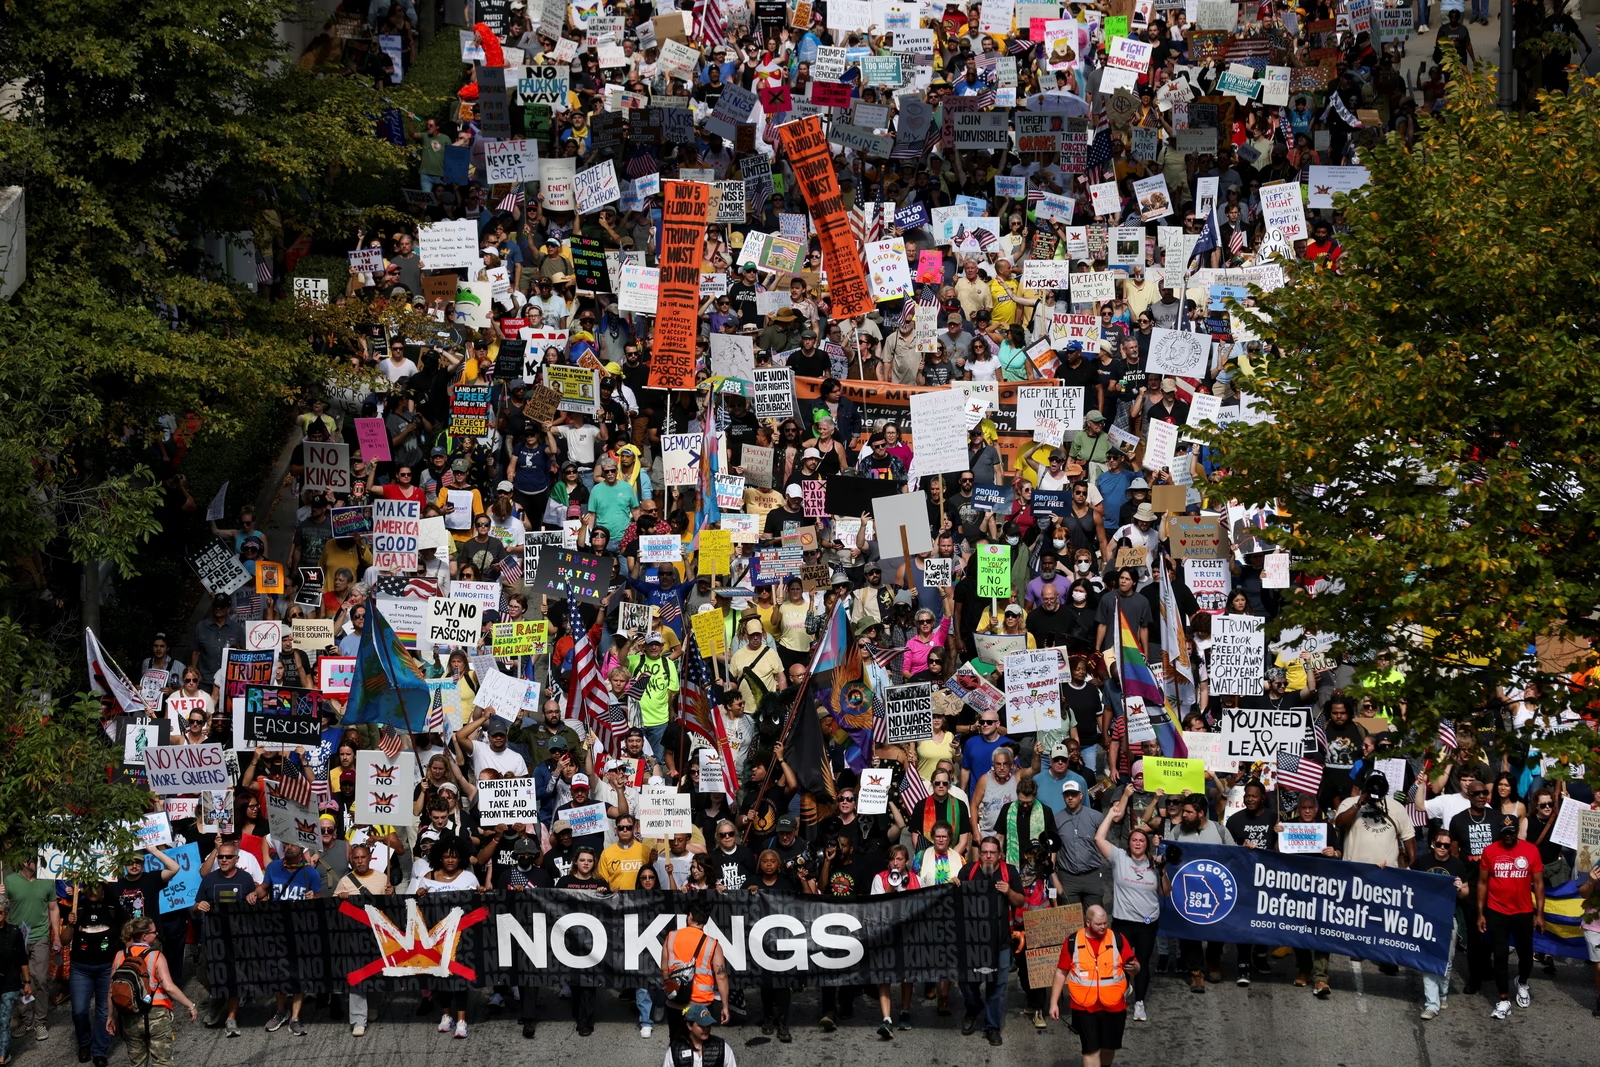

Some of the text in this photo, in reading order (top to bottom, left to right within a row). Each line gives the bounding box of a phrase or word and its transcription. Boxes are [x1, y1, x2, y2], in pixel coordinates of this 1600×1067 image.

[1120, 42, 1147, 56] FIGHT
[865, 63, 896, 71] TOO HIGH?
[1108, 56, 1148, 73] DEMOCRACY!
[1268, 70, 1287, 81] Free
[958, 115, 981, 125] JOIN
[1018, 116, 1048, 125] THREAT
[1021, 125, 1045, 133] LEVEL
[954, 131, 1008, 142] INDIVISIBLE!
[488, 140, 527, 154] HATE
[1019, 135, 1056, 151] ORANGE
[1061, 143, 1087, 151] FORGETS
[487, 154, 522, 168] NEVER
[548, 183, 571, 192] ENEMY
[902, 214, 920, 224] TACO
[666, 228, 700, 244] TRUMP
[349, 250, 381, 259] PREDATOR
[667, 248, 694, 264] MUST
[353, 264, 379, 272] CHIEF
[1071, 272, 1114, 284] DICTATOR?
[627, 279, 658, 289] NO KINGS
[1053, 314, 1095, 325] NO KING
[1070, 327, 1082, 336] IN
[654, 355, 690, 366] REFUSE
[650, 366, 693, 378] FASCISM
[754, 370, 788, 382] WE WON
[657, 376, 683, 387] .ORG
[755, 382, 789, 391] OUR RIGHTS
[457, 393, 485, 401] FREE
[756, 393, 790, 403] WE WON'T
[1020, 388, 1082, 398] KEEP THE HEAT
[453, 407, 486, 415] BRAVE
[757, 402, 791, 412] GO BACK!
[1034, 409, 1076, 419] UNTIL IT
[454, 420, 484, 428] REJECT
[450, 427, 488, 436] FASCISM!
[310, 446, 339, 470] NO
[306, 468, 347, 488] KINGS
[804, 480, 815, 490] NO
[976, 488, 999, 496] PROUD
[1034, 492, 1057, 500] PROUD
[376, 502, 418, 518] MAKE
[374, 520, 419, 536] AMERICA
[375, 536, 416, 551] GOOD
[194, 544, 222, 568] FREE
[1184, 548, 1218, 556] AMERICA
[198, 550, 232, 578] SPEECH
[374, 553, 416, 568] AGAIN
[558, 552, 598, 566] TRUMP
[1192, 560, 1223, 568] FIGHT
[925, 560, 950, 572] People
[207, 560, 235, 584] FREE
[558, 568, 596, 581] HATES
[803, 572, 830, 580] ABOLISH
[210, 566, 243, 593] PRESS
[816, 579, 830, 588] ICE
[987, 576, 1000, 585] NO
[1193, 580, 1225, 588] DECAY
[434, 600, 476, 618] SAY NO
[625, 606, 637, 614] NO
[307, 625, 330, 633] SPEECH,
[445, 619, 459, 628] TO
[516, 623, 545, 635] RAGE
[430, 626, 476, 643] FASCISM
[1214, 636, 1251, 645] WE TOOK
[493, 645, 533, 656] MAGA KING
[1211, 655, 1264, 667] SPEECH AWAY
[230, 662, 272, 682] TRUMP
[1216, 666, 1259, 680] OH YEAH?
[1007, 678, 1057, 692] MORE WARMTH!
[887, 698, 930, 714] NO KINGS
[136, 717, 152, 725] RIP
[888, 712, 931, 727] NO WARS
[1261, 712, 1302, 726] NEED
[889, 724, 932, 735] NO EMPIRES
[1250, 730, 1272, 743] TO
[145, 748, 222, 770] NO KINGS
[1157, 760, 1189, 768] DEMOCRACY
[151, 769, 225, 787] MORE QUEENS
[375, 777, 392, 785] NO
[480, 779, 532, 789] CHRISTIANS
[375, 805, 392, 813] NO
[488, 799, 527, 808] TAKE AID
[480, 809, 537, 819] FROM THE POOR
[1244, 825, 1268, 833] RACISM
[1469, 824, 1491, 832] HATE
[298, 832, 316, 840] NO
[620, 862, 642, 871] LOVE
[723, 867, 738, 877] NO
[1494, 863, 1514, 871] FIGHT
[1495, 870, 1528, 878] LIKE HELL!
[1197, 864, 1233, 901] GEORGIA
[1254, 863, 1414, 909] Democracy Doesn't
[163, 881, 186, 897] Eyes
[1257, 892, 1316, 921] Defend
[1413, 914, 1437, 942] Do.
[496, 912, 864, 972] NO KNGS
[1251, 920, 1276, 930] 50501
[1279, 923, 1312, 934] Georgia
[1320, 927, 1371, 945] 50501ga.org
[1378, 937, 1421, 953] #50501GA
